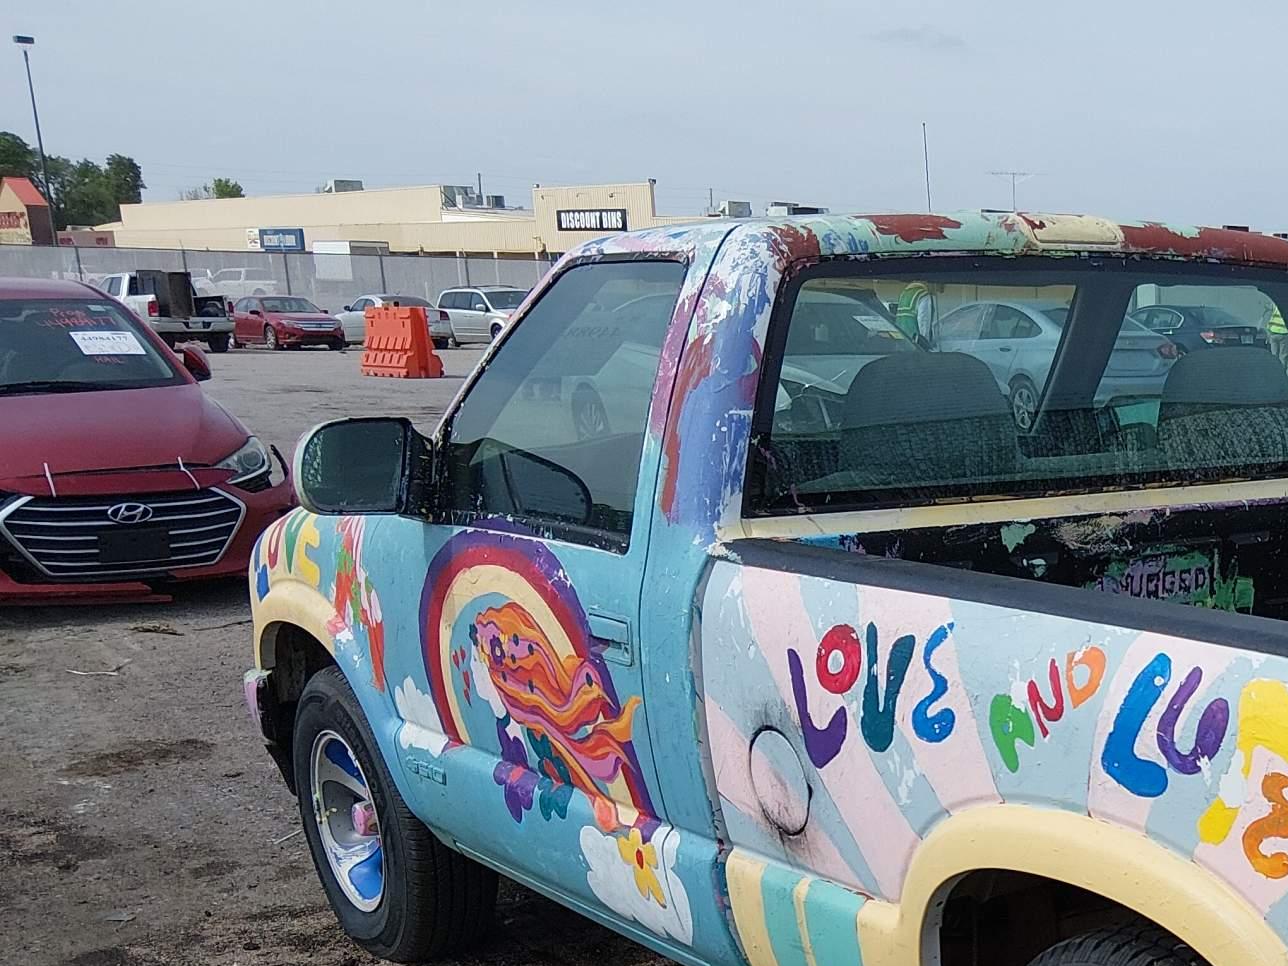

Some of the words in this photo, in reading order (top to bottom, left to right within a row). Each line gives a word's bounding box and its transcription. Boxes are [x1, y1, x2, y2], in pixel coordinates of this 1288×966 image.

[560, 211, 600, 229] DISCOUNT
[602, 211, 623, 229] BINS
[787, 621, 957, 769] LOVE
[989, 643, 1107, 773] AND
